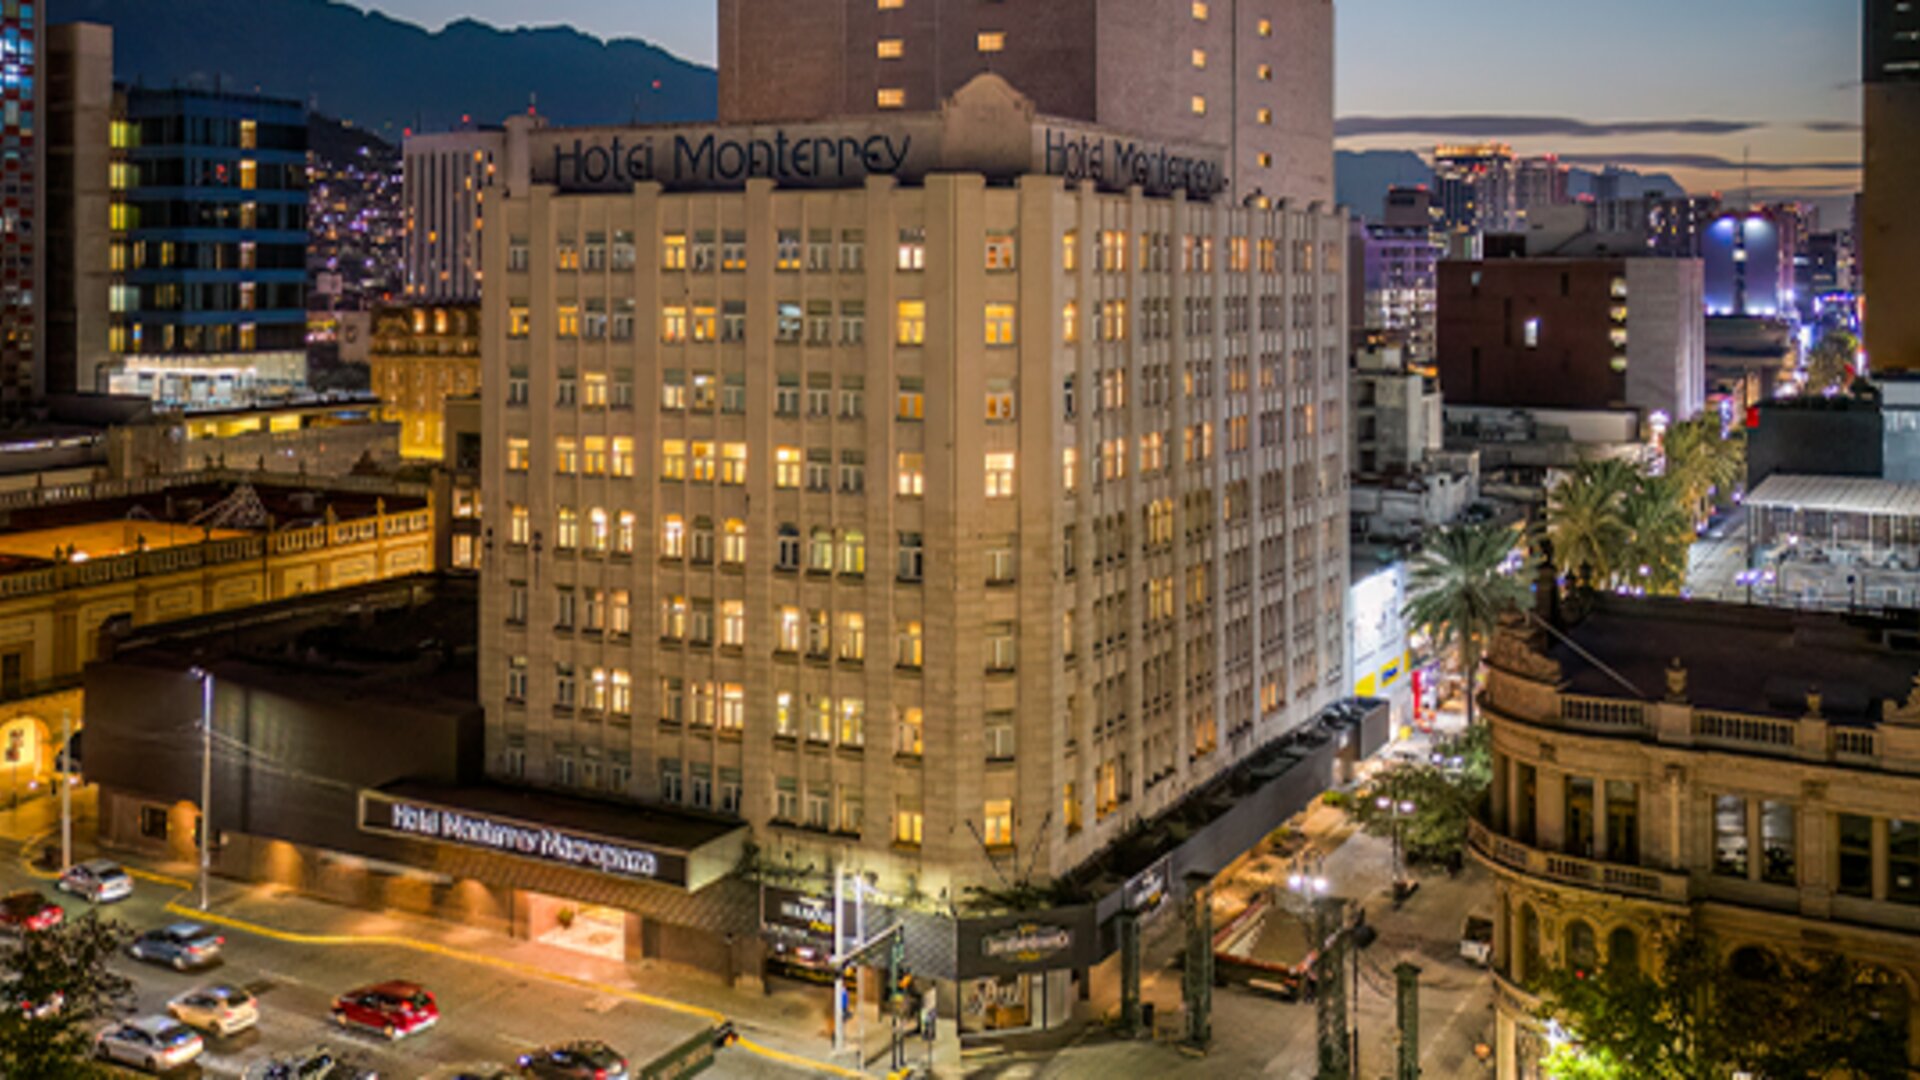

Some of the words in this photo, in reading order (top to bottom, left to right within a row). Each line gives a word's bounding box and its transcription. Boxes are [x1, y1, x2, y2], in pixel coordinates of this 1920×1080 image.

[553, 137, 655, 184] Hotel
[674, 130, 911, 180] Monterrey
[392, 804, 439, 834] Hotel
